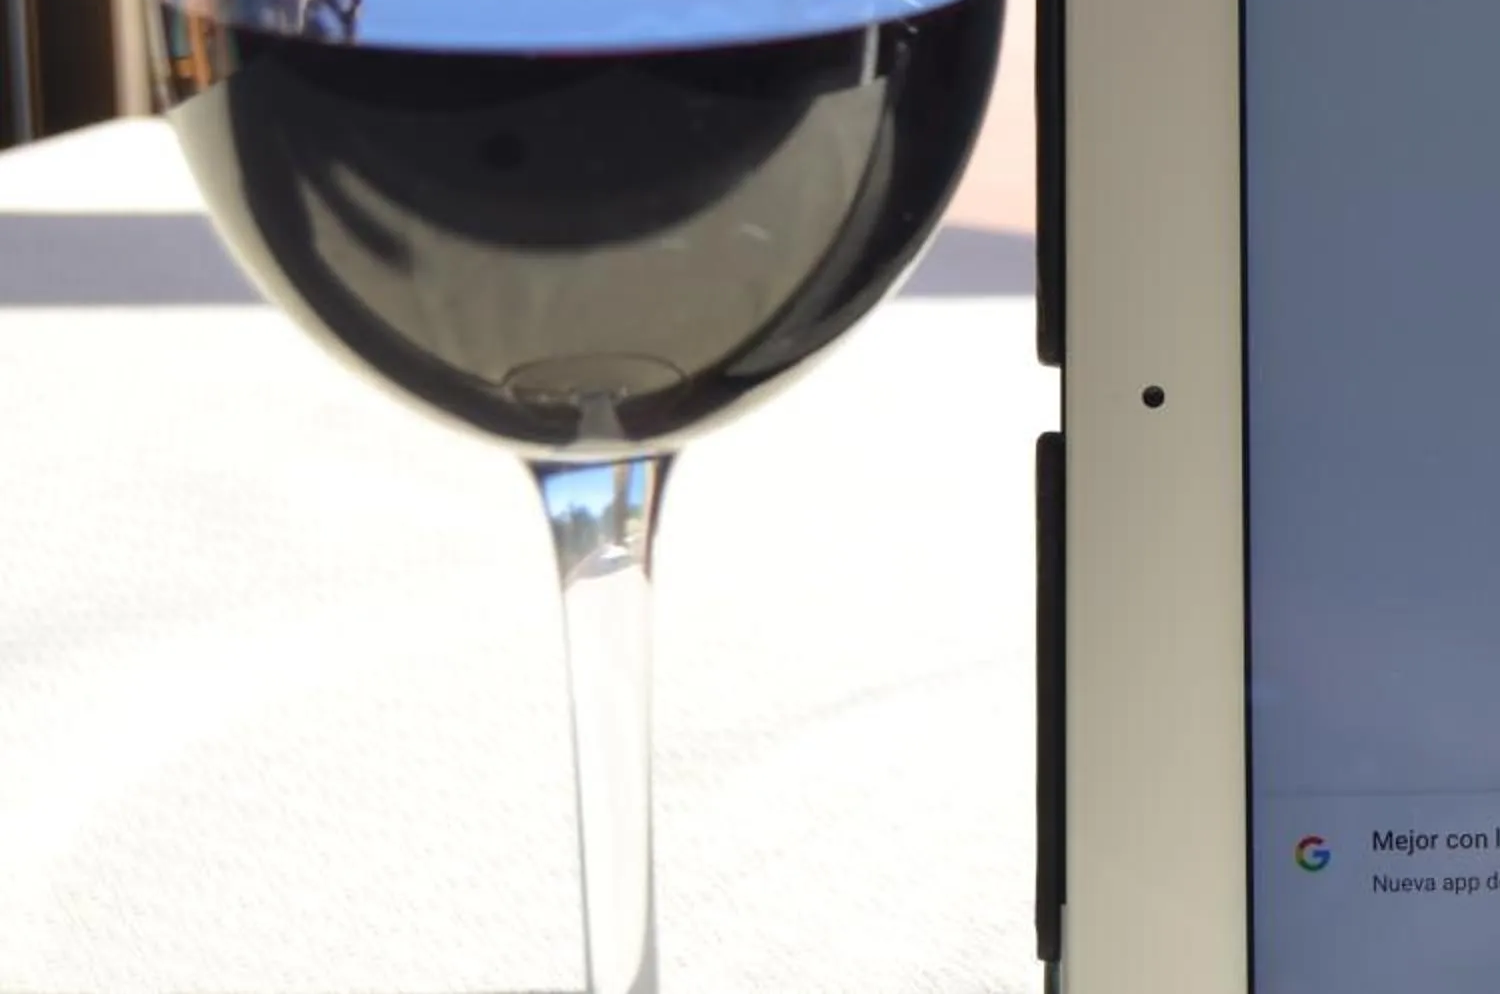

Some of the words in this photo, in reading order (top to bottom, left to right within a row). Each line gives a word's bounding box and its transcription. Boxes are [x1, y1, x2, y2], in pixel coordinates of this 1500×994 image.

[1295, 835, 1331, 872] G
[1371, 830, 1439, 856] Mejor
[1446, 831, 1488, 850] con
[1372, 874, 1436, 893] Nueva
[1442, 876, 1480, 896] app
